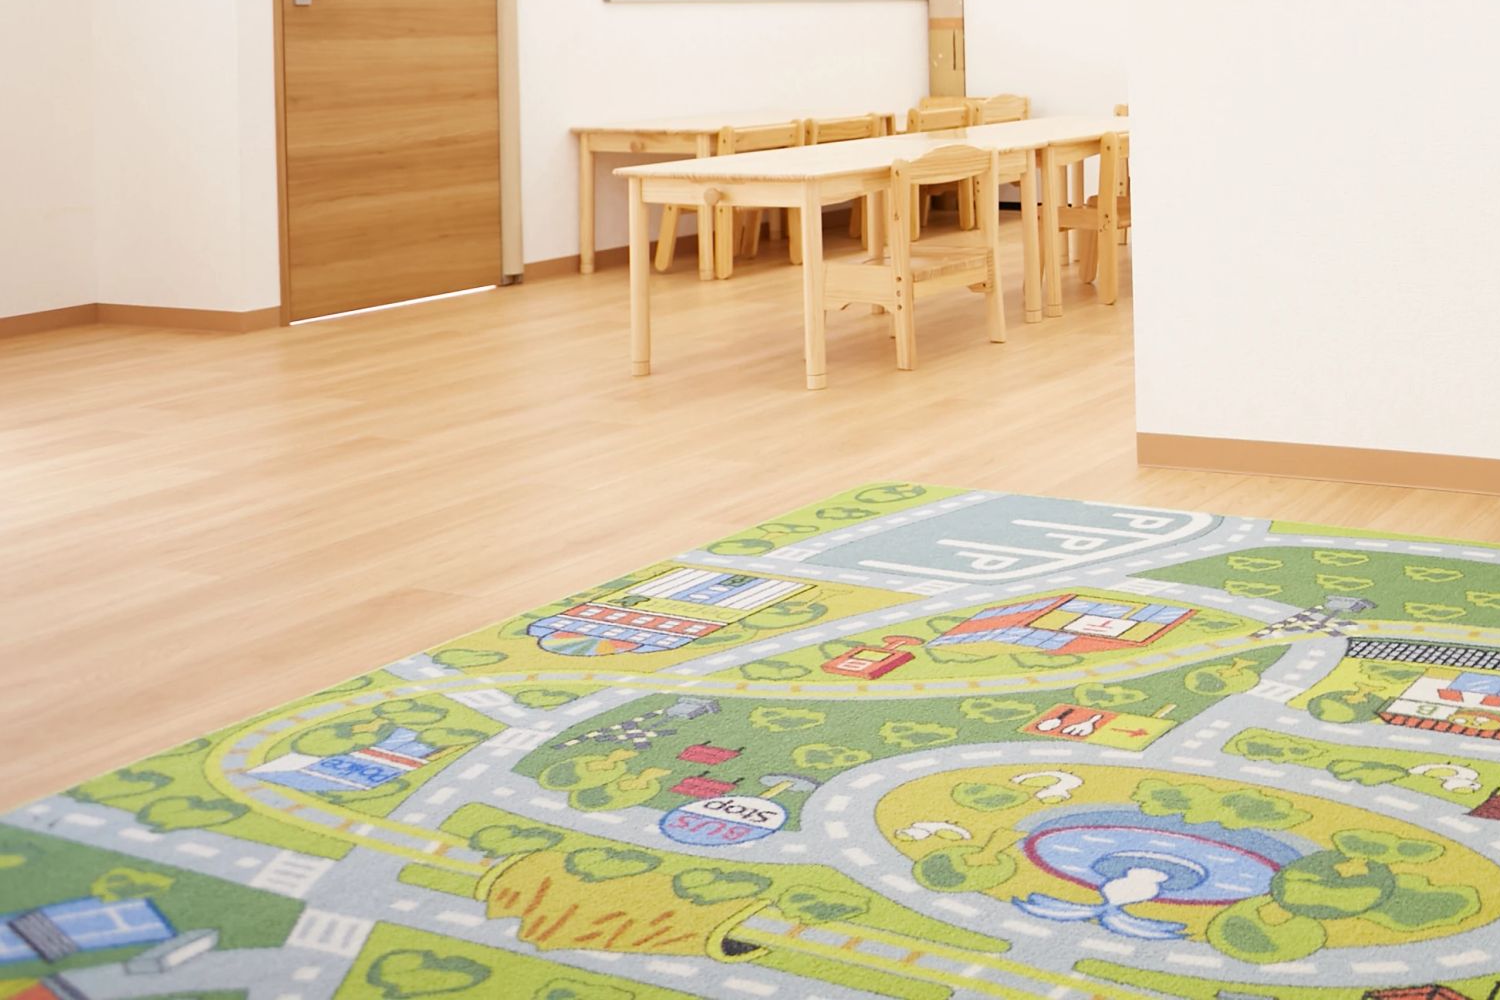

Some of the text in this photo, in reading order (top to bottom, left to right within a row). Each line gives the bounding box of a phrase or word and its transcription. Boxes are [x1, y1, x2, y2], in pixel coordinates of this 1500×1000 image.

[1112, 512, 1175, 529] P
[1045, 532, 1108, 550] P
[954, 551, 1020, 571] P
[320, 758, 402, 782] Police
[704, 799, 778, 823] Stop
